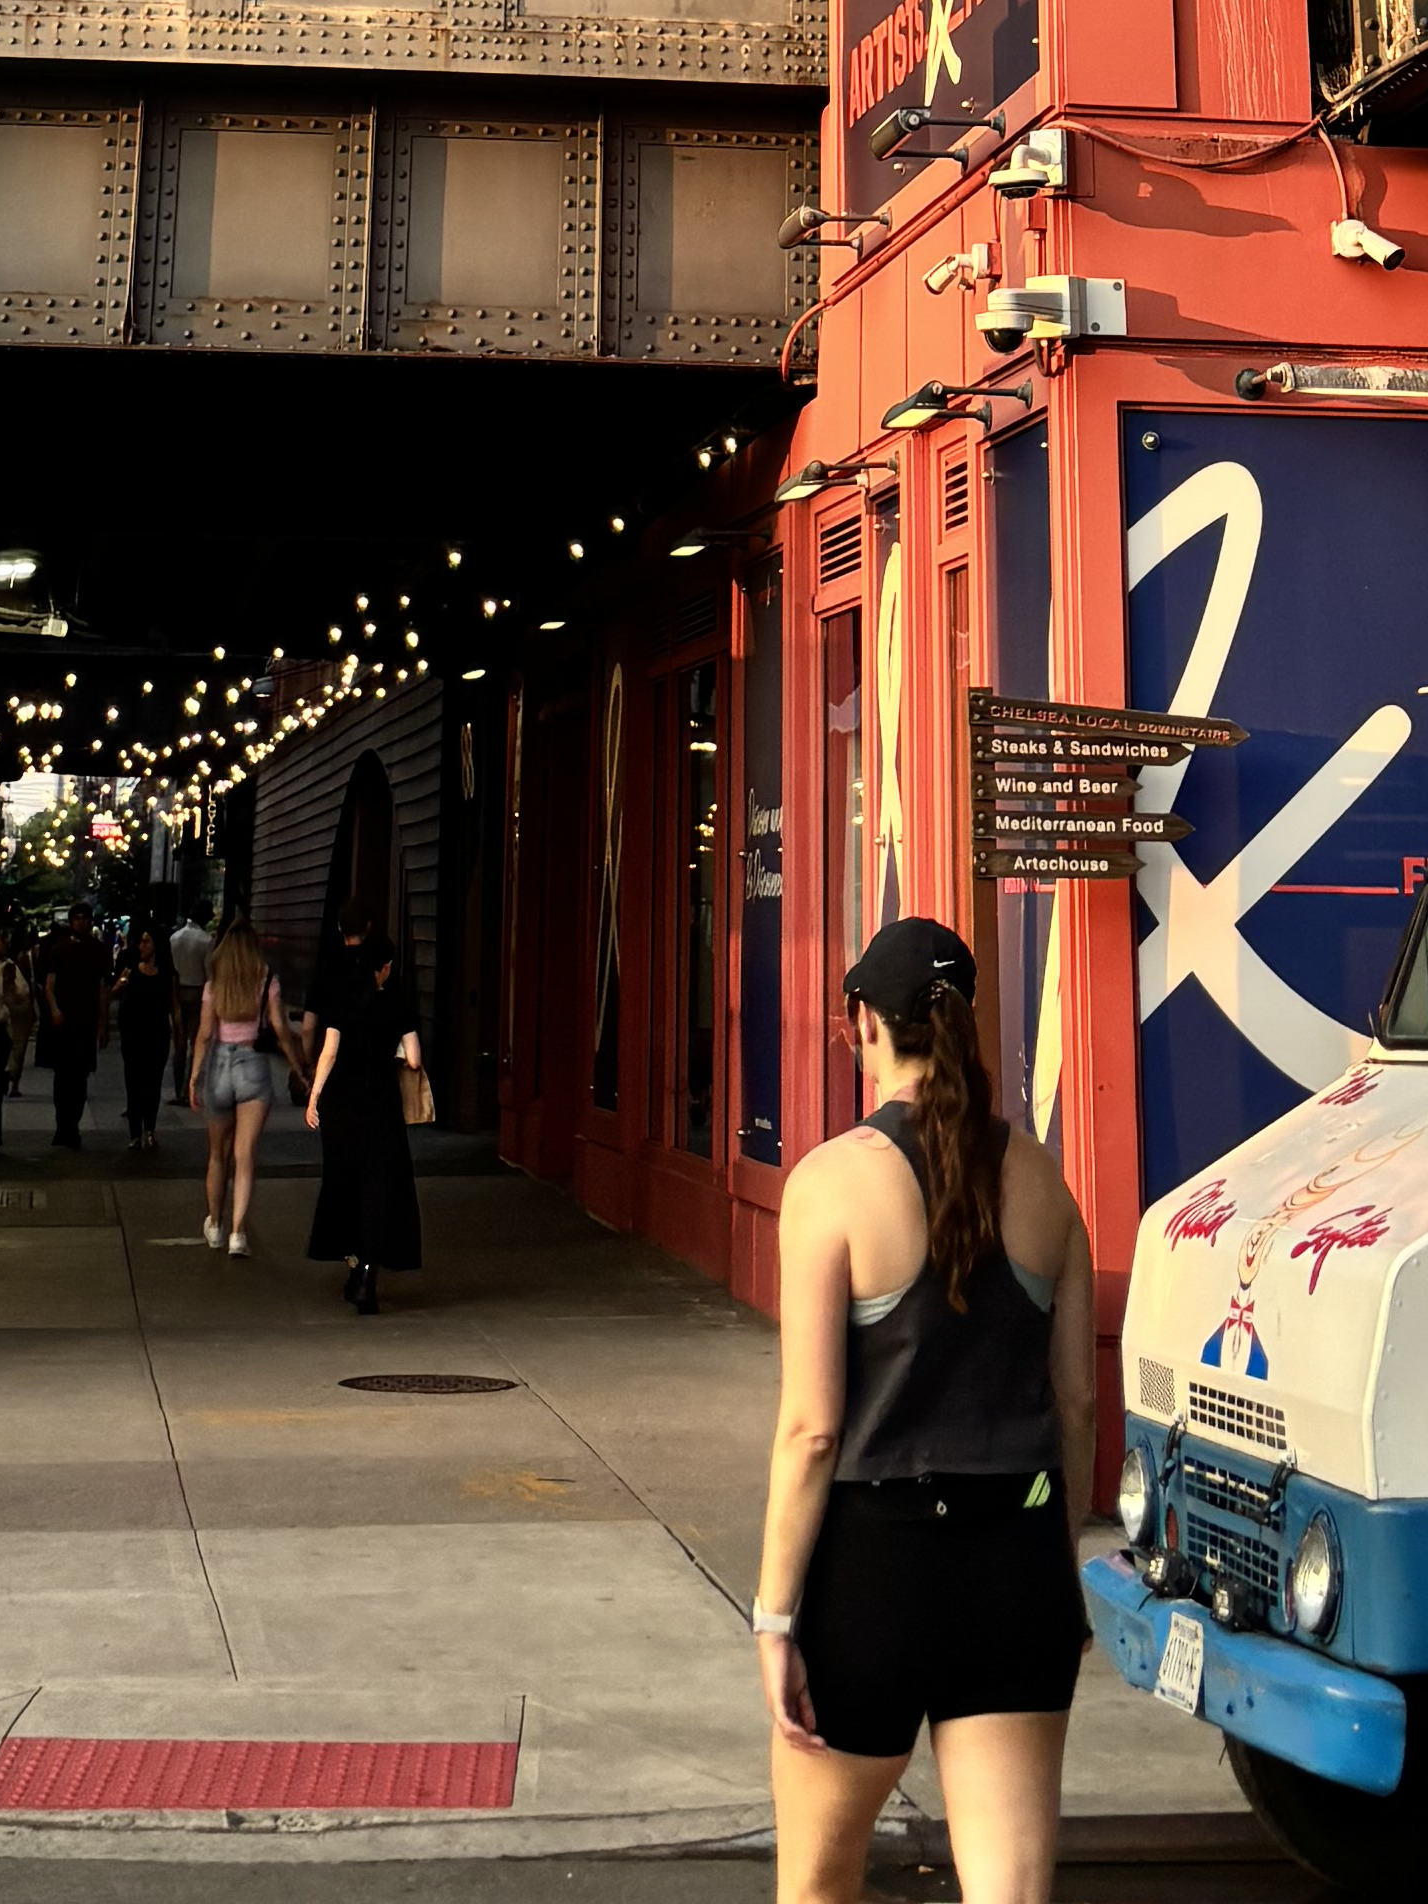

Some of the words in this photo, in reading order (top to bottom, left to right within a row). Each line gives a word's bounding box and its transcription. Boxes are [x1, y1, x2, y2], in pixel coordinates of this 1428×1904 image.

[990, 704, 1070, 725] CHELSEA
[1075, 713, 1133, 733] LOCAL
[991, 739, 1047, 755] Steaks
[1053, 740, 1065, 755] &
[1069, 741, 1169, 758] Sandwiches
[995, 778, 1036, 793] Wine
[1042, 778, 1073, 793] and
[1079, 779, 1118, 794] Beer
[995, 816, 1116, 833] Mediterranean
[1122, 818, 1165, 834] Food
[1013, 855, 1109, 872] Artechouse
